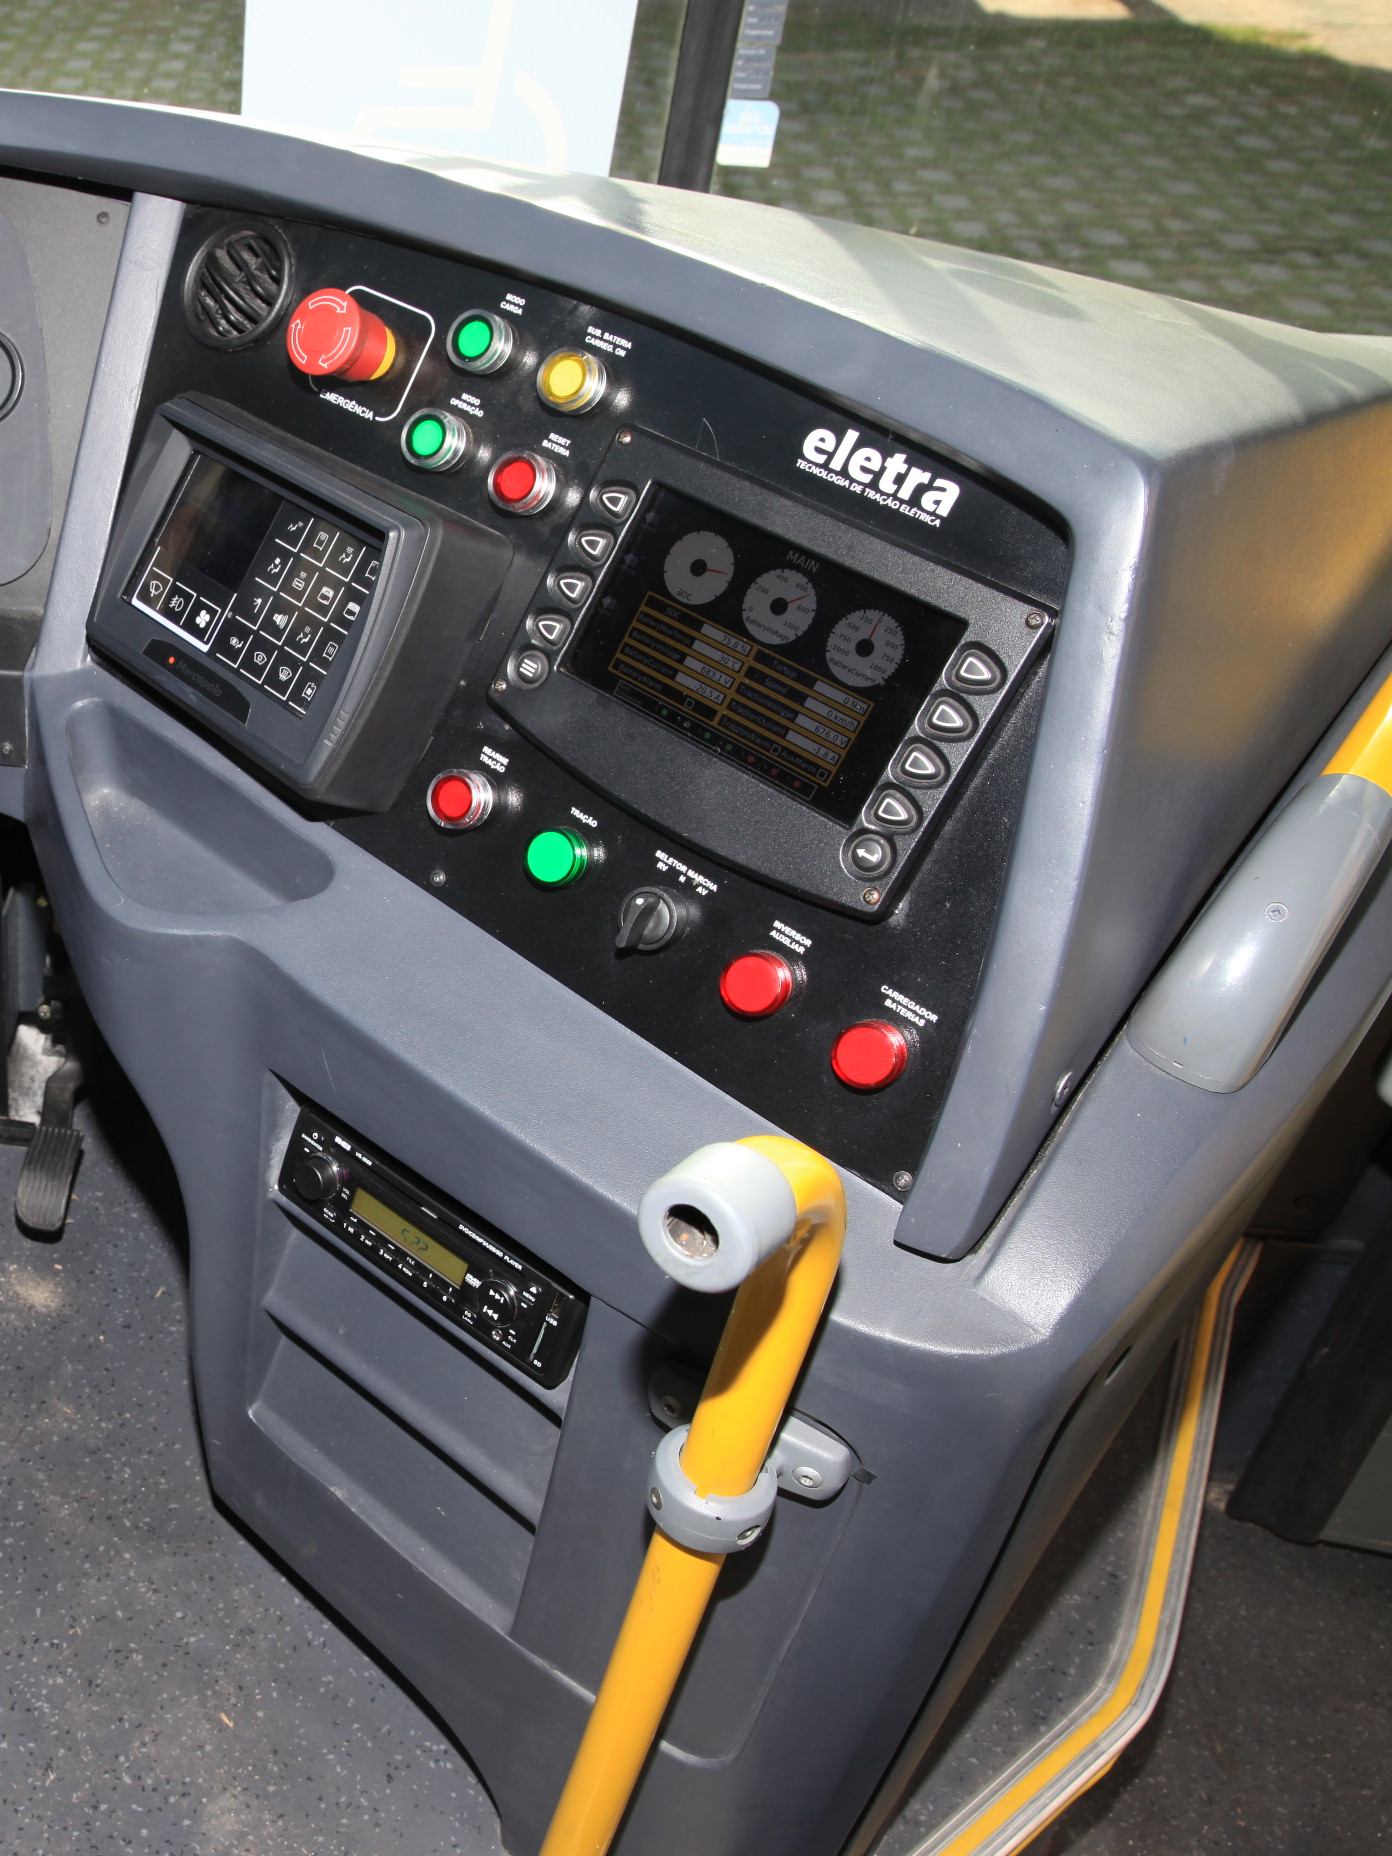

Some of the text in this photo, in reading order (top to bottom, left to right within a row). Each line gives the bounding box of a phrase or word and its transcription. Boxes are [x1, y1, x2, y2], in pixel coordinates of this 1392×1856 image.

[506, 293, 526, 306] MODO
[500, 301, 523, 316] CARGA
[587, 326, 632, 349] SUB. BATERIA
[585, 336, 627, 357] CARREG. ON
[319, 388, 374, 421] EMERGÊNCIA
[461, 392, 481, 405] MODO
[450, 398, 484, 418] OPERAÇÃO
[549, 432, 571, 447] RESET
[542, 440, 570, 457] BATERIA
[803, 428, 960, 517] eletra
[796, 458, 941, 528] TECNOLOGIA DE TRAÇÃO ELÉTRICA
[786, 550, 820, 573] MAIN
[776, 574, 789, 583] 400
[676, 588, 694, 601] SOC
[756, 585, 769, 595] 200
[796, 583, 808, 592] 600
[797, 604, 810, 614] 800
[745, 616, 790, 641] BatteryVoltage
[784, 621, 800, 632] 1000
[884, 626, 898, 636] 250
[721, 635, 749, 654] 75.8 %
[885, 641, 899, 650] 500
[624, 646, 674, 676] BatteryCurrent
[718, 655, 730, 665] 30
[881, 654, 895, 664] 750
[700, 666, 732, 685] 683.1 V
[772, 660, 798, 679] Torque
[828, 657, 877, 684] BatteryCurrent
[869, 662, 887, 675] 1000
[176, 660, 222, 696] Marcopolo
[765, 678, 788, 694] Speed
[714, 694, 721, 703] A
[843, 697, 850, 705] 0
[730, 701, 786, 735] TractionCurrent
[826, 710, 856, 730] 0 km/h
[815, 725, 848, 746] 676.0 V
[479, 753, 505, 773] TRAÇÃO
[482, 746, 509, 766] REARME
[829, 754, 837, 764] A
[570, 806, 598, 828] TRAÇÃO
[655, 850, 718, 892] SELETOR MARCHA
[656, 861, 668, 872] RV
[678, 875, 686, 883] N
[696, 886, 708, 896] AV
[769, 929, 806, 955] AUXILIAR
[773, 920, 813, 948] INVERSOR
[880, 985, 939, 1023] CARREGADOR
[884, 998, 926, 1027] BATERIAS
[504, 1255, 523, 1271] PLAYER
[545, 1315, 558, 1327] USB
[533, 1359, 542, 1368] SD
